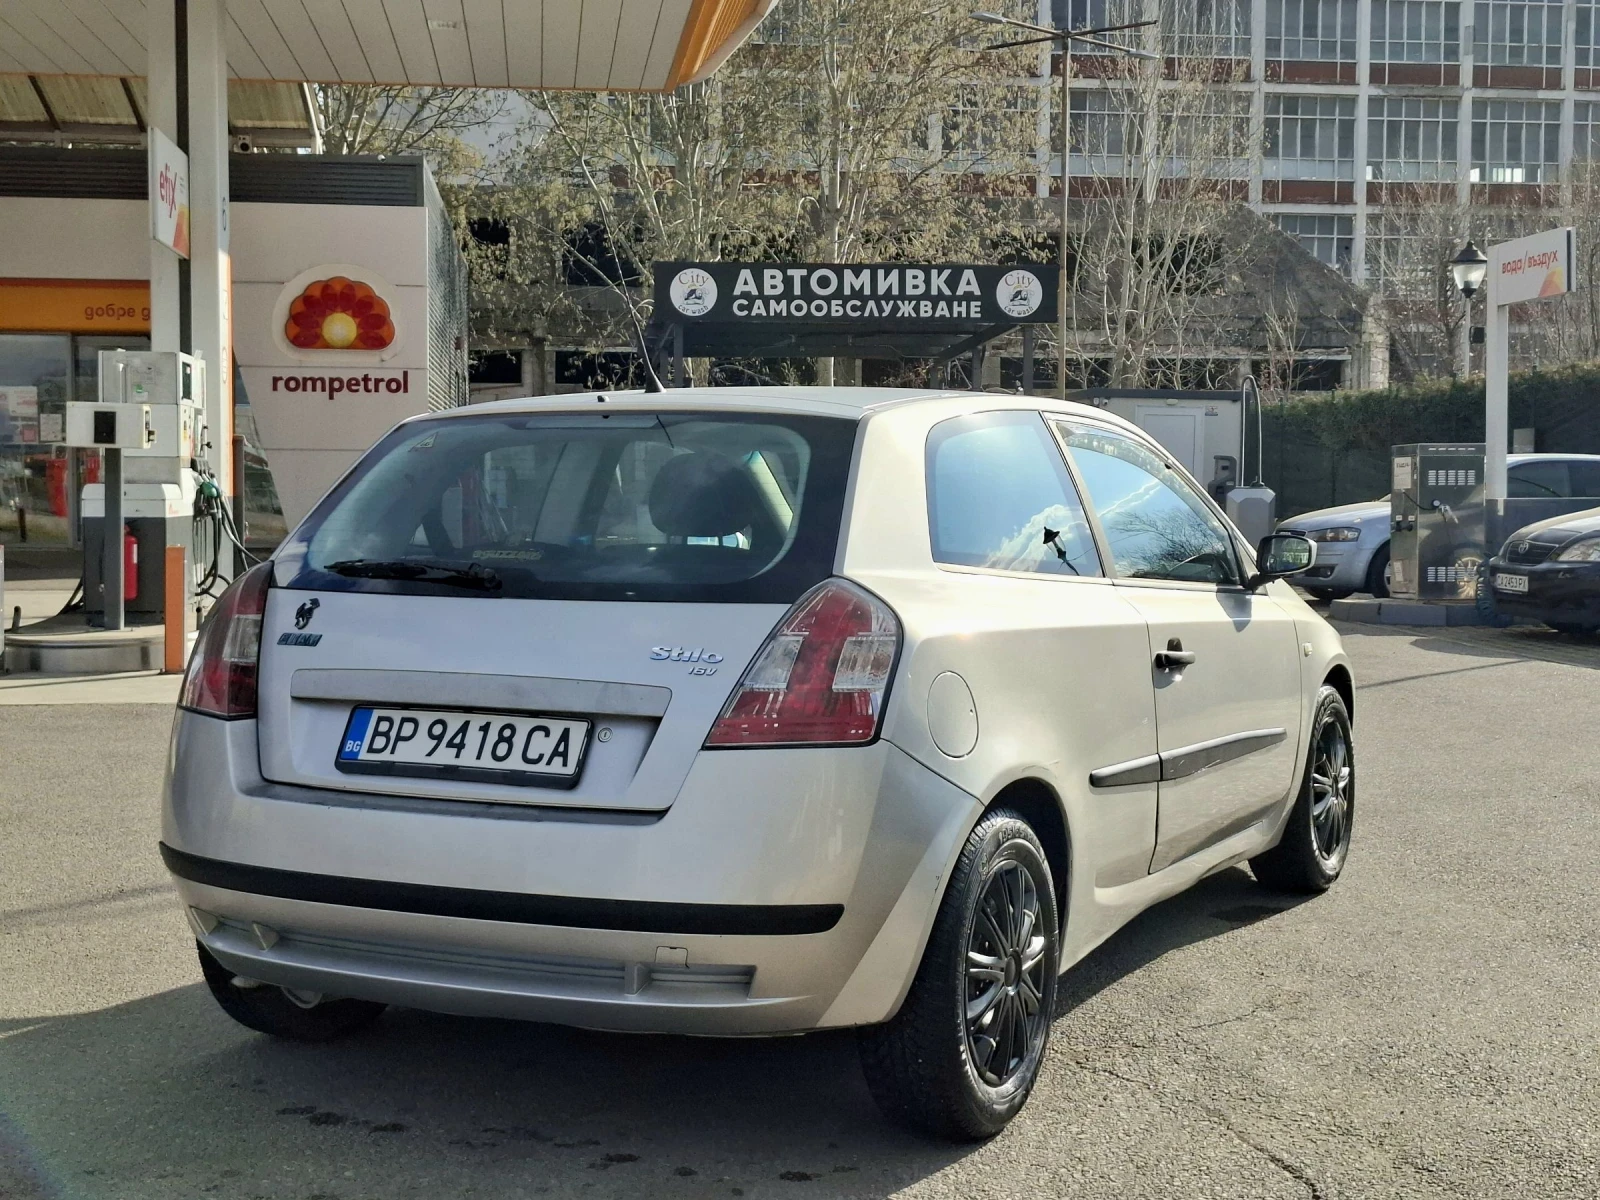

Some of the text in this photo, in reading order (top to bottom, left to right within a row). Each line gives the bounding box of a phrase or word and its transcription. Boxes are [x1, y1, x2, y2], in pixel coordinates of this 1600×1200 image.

[159, 162, 178, 219] efix
[678, 271, 709, 287] City
[732, 268, 982, 297] АВТОМИВКА
[1004, 272, 1035, 288] City
[732, 298, 982, 319] САМООБСЛУЖВАНЕ
[272, 370, 409, 401] rompetrol
[649, 646, 724, 664] Stilo
[345, 740, 361, 752] BG
